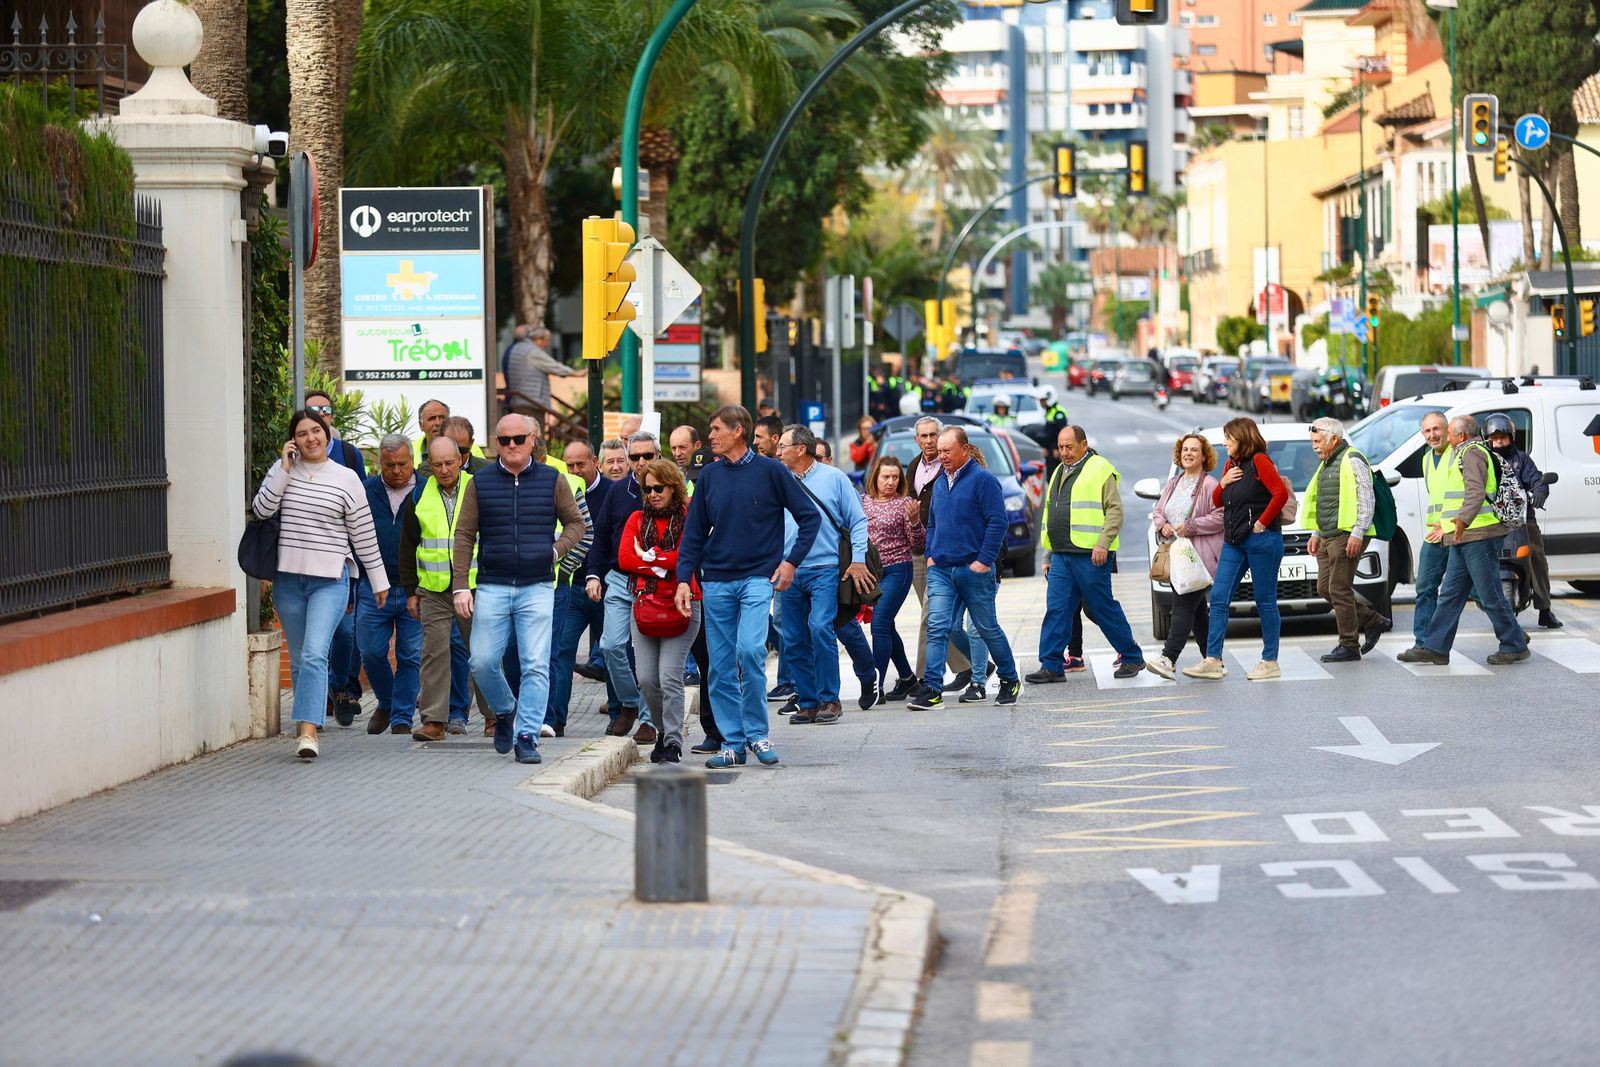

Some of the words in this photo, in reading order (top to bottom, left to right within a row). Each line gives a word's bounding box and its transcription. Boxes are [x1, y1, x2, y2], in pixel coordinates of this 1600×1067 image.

[387, 208, 470, 225] earprotech
[396, 371, 411, 379] 526
[428, 371, 442, 379] 607
[443, 371, 458, 379] 628
[809, 406, 820, 420] P
